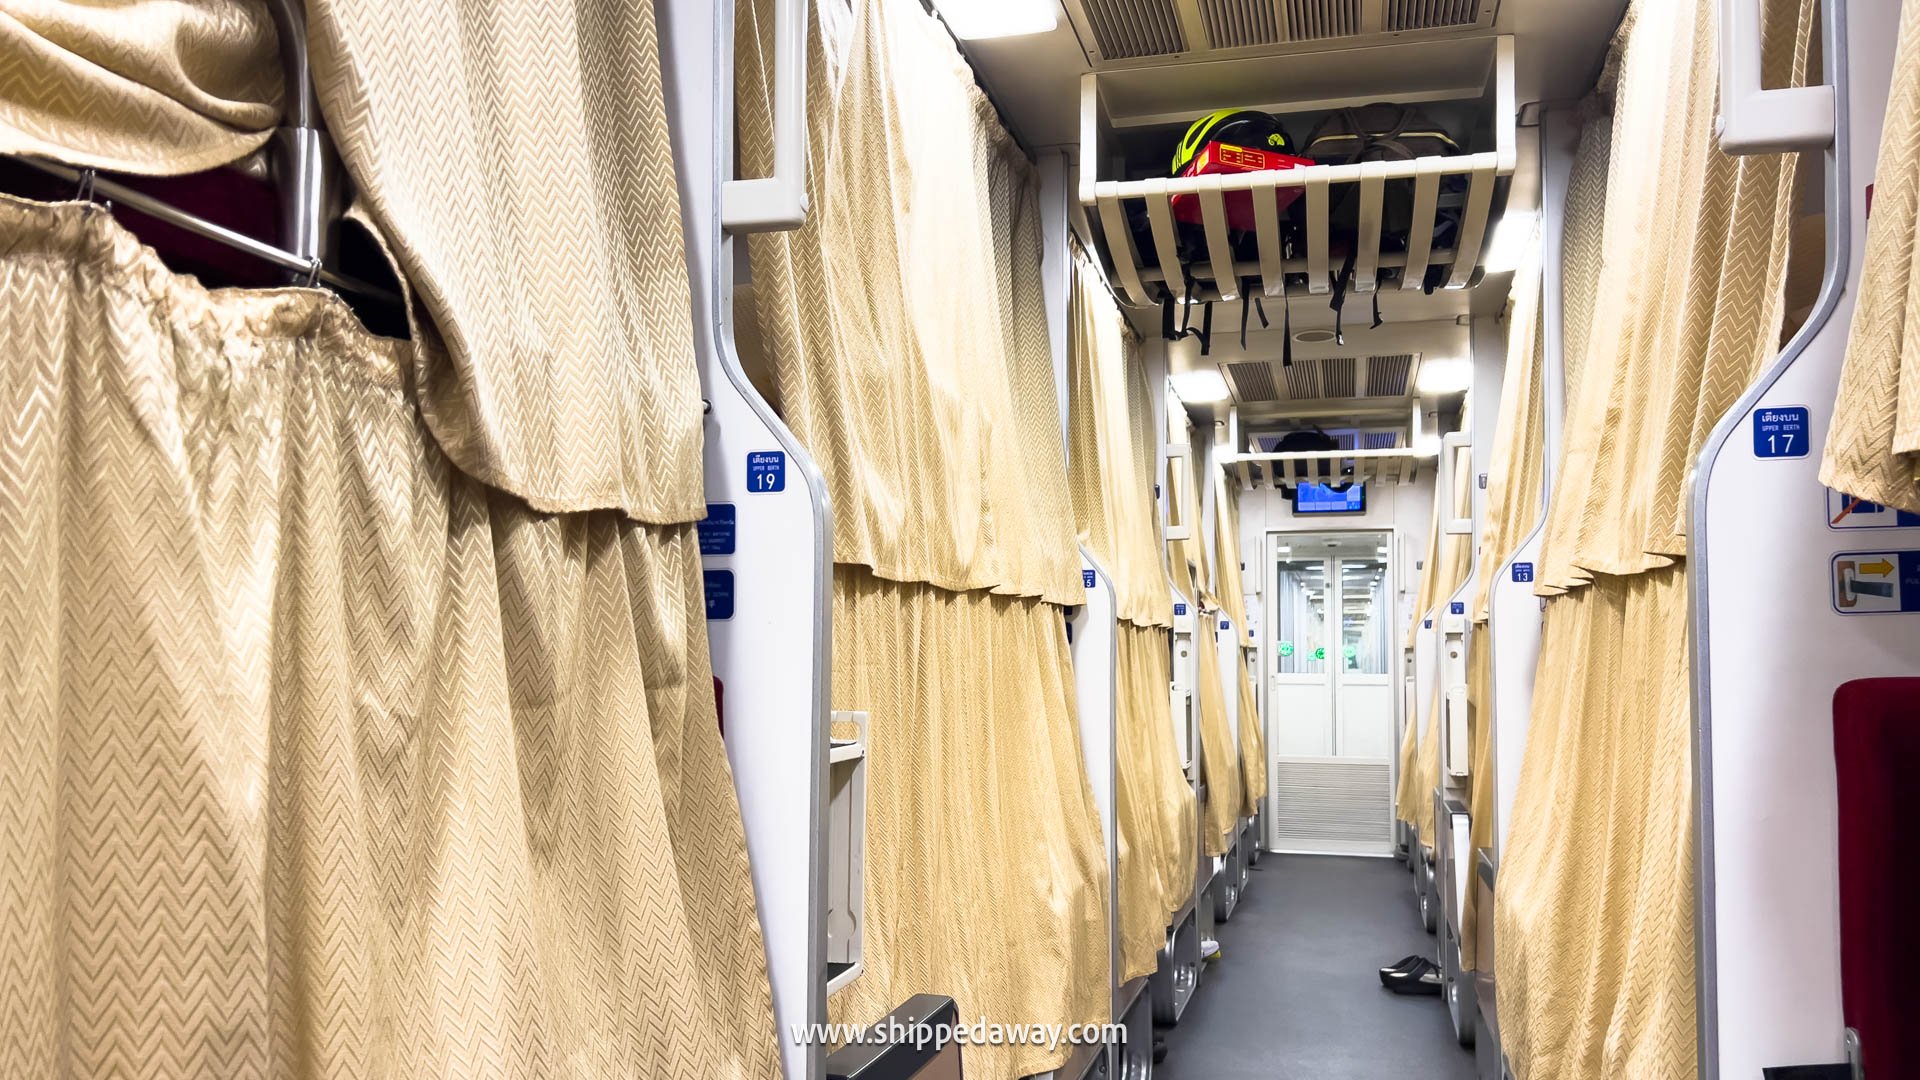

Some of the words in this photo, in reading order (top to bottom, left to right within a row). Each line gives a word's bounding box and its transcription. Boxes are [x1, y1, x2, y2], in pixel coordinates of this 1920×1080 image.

[1762, 411, 1799, 422] เตียงบน
[1767, 434, 1794, 454] 17
[756, 473, 775, 490] 19
[1517, 572, 1528, 582] 13
